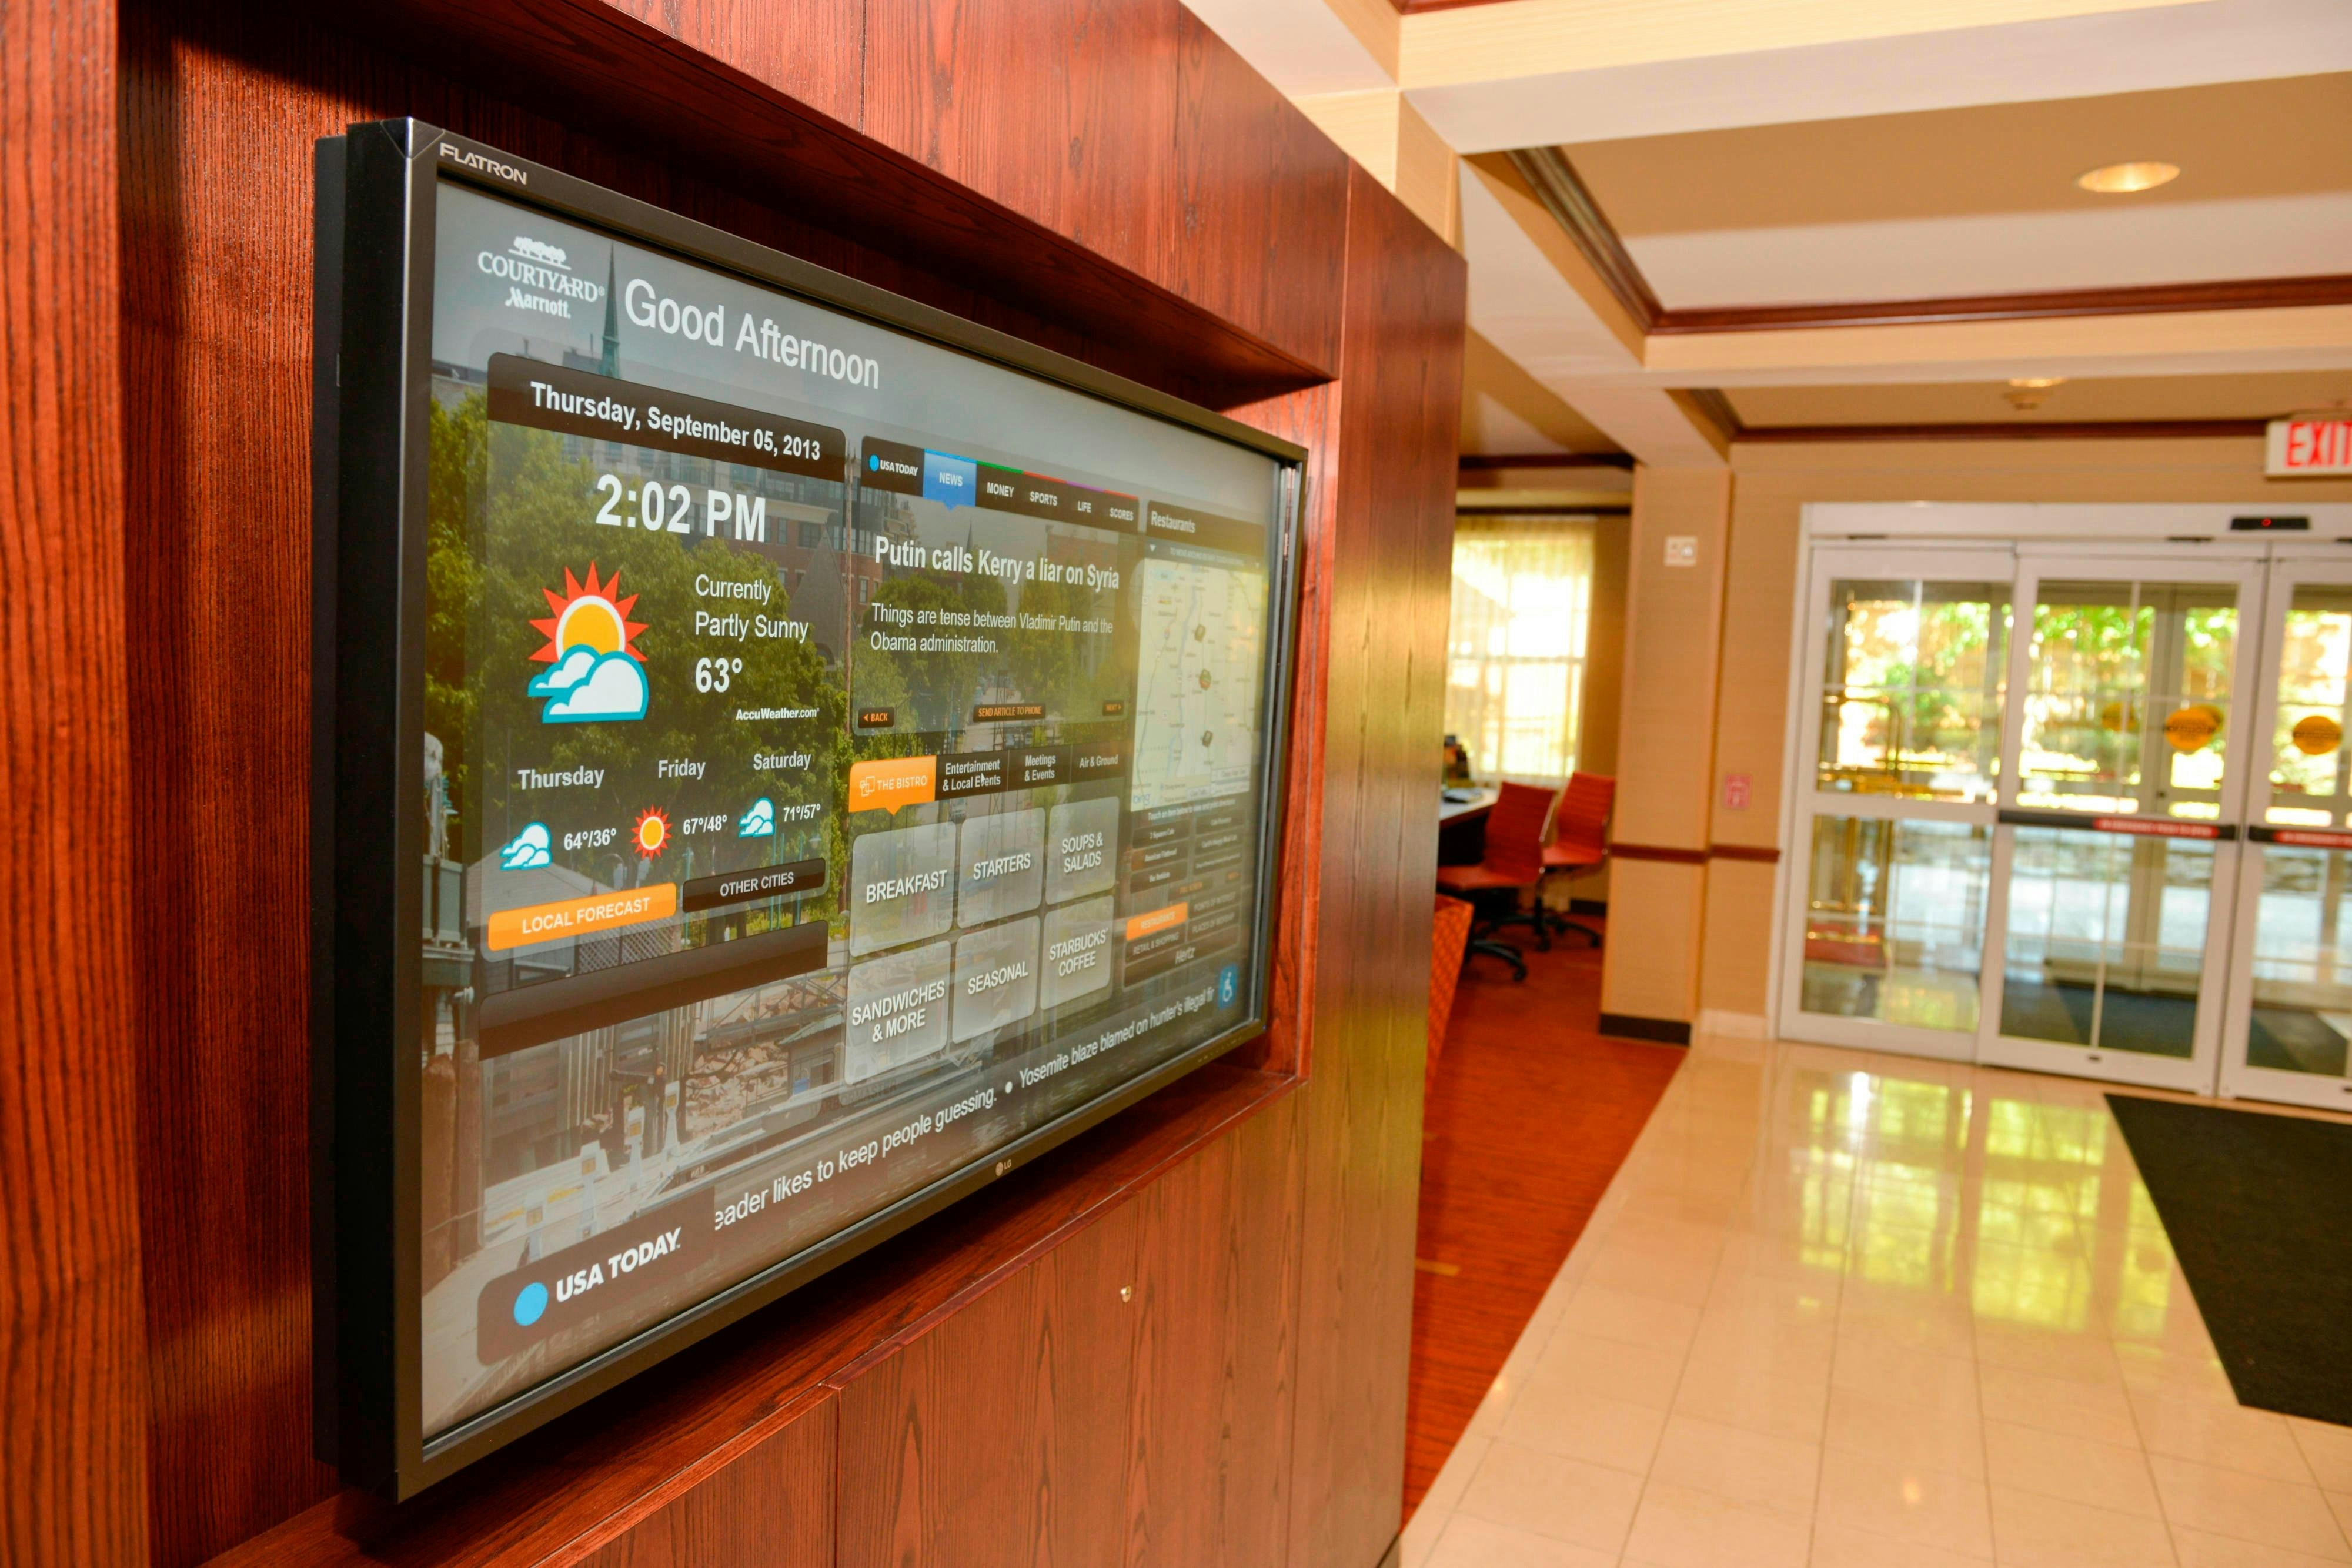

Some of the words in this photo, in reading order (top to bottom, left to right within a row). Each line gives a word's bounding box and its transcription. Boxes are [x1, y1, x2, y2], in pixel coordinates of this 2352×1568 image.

[440, 142, 527, 185] FLATRON
[624, 279, 724, 347] Good
[735, 312, 879, 390] Afternoon
[530, 381, 641, 431] Thursday,
[647, 406, 749, 448] September
[753, 429, 779, 457] 05,
[783, 433, 820, 461] 2013
[2285, 421, 2352, 467] EXIT
[939, 472, 963, 487] NEWS
[987, 482, 1014, 498] MONEY
[596, 474, 691, 534] 2:02
[707, 490, 765, 543] PM
[1030, 491, 1058, 506] SPORTS
[1077, 501, 1091, 513] LIFE
[1110, 507, 1134, 521] SCORES
[1151, 510, 1195, 533] Restaurants
[875, 536, 926, 569] Putin
[932, 546, 973, 573] calls
[978, 550, 1023, 584] Kerry
[1026, 563, 1034, 580] a
[1039, 557, 1063, 583] liar
[1066, 566, 1083, 585] on
[1087, 563, 1120, 593] Syria
[695, 573, 771, 604] Currently
[695, 611, 750, 643] Partly
[754, 616, 809, 644] Sunny
[871, 602, 914, 628] Things
[917, 608, 937, 624] are
[940, 609, 971, 627] tense
[973, 609, 1016, 629] between
[1019, 613, 1057, 631] Vladimir
[1058, 616, 1081, 633] Putin
[1083, 618, 1098, 634] and
[1100, 618, 1113, 634] the
[870, 631, 916, 651] Obama
[920, 634, 999, 653] administration.
[695, 657, 743, 693] 63°
[870, 712, 888, 723] BACK
[978, 707, 993, 718] SEND
[994, 707, 1016, 717] ARTICLE
[1017, 706, 1024, 716] TO
[1024, 705, 1042, 715] PHONE
[658, 758, 706, 781] Friday
[753, 751, 812, 772] Saturday
[945, 758, 1000, 775] Entertainment
[1025, 754, 1056, 768] Meetings
[1079, 758, 1089, 768] Air
[1090, 757, 1095, 767] &
[1096, 754, 1118, 766] Ground
[517, 765, 604, 790] Thursday
[877, 779, 895, 791] THE
[897, 775, 927, 789] BISTRO
[943, 781, 949, 791] &
[951, 777, 973, 791] Local
[1024, 771, 1031, 782] &
[1032, 770, 1055, 781] Events
[1061, 833, 1095, 855] SOUPS
[1096, 832, 1104, 847] &
[973, 852, 1031, 881] STARTERS
[1064, 851, 1102, 874] SALADS
[720, 875, 759, 898] OTHER
[760, 871, 794, 890] CITIES
[866, 870, 948, 904] BREAKFAST
[522, 910, 573, 935] LOCAL
[576, 897, 650, 925] FORECAST
[1058, 951, 1096, 977] COFFEE
[1175, 945, 1195, 965] Hertz
[967, 961, 1028, 995] SEASONAL
[851, 981, 946, 1027] SANDWICHES
[871, 1022, 883, 1043] &
[885, 1008, 926, 1039] MORE
[773, 1170, 813, 1204] likes
[818, 1159, 834, 1182] to
[838, 1140, 877, 1174] keep
[882, 1118, 931, 1158] people
[935, 1087, 997, 1132] guessing.
[1020, 1054, 1069, 1088] Yosemite
[1071, 1041, 1098, 1066] blaze
[1100, 1019, 1134, 1052] blamed
[1136, 1018, 1148, 1035] on
[1184, 990, 1205, 1015] illegal
[1004, 1159, 1012, 1170] LG
[556, 1263, 604, 1303] USA
